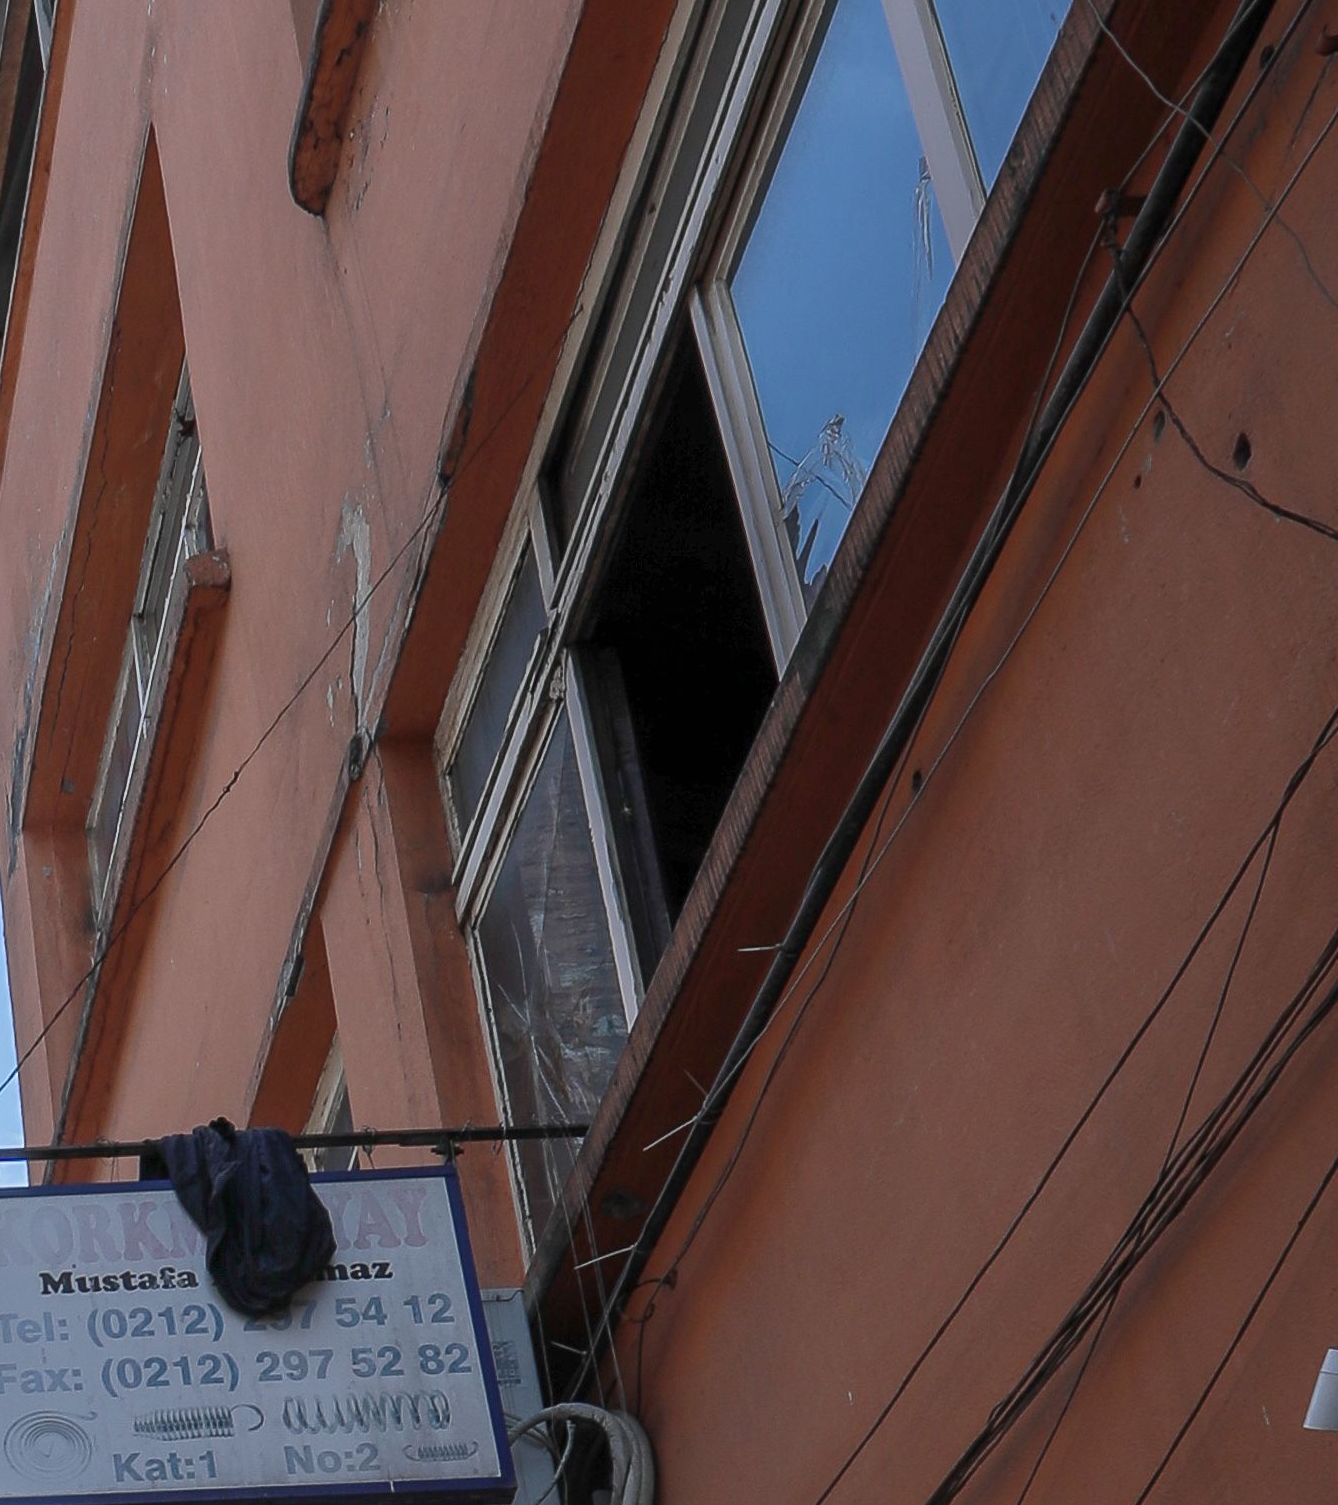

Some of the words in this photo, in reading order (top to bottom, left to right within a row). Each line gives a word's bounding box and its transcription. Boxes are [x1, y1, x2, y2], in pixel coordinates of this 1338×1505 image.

[39, 1268, 199, 1295] Mustafa
[87, 1303, 224, 1347] (0212)
[335, 1296, 387, 1328] 54
[404, 1293, 455, 1325] 12
[102, 1352, 239, 1397] (0212)
[255, 1349, 335, 1382] 297
[351, 1345, 406, 1378] 52
[418, 1341, 473, 1374] 82
[113, 1449, 218, 1483] Kat:1
[284, 1443, 381, 1475] No:2
